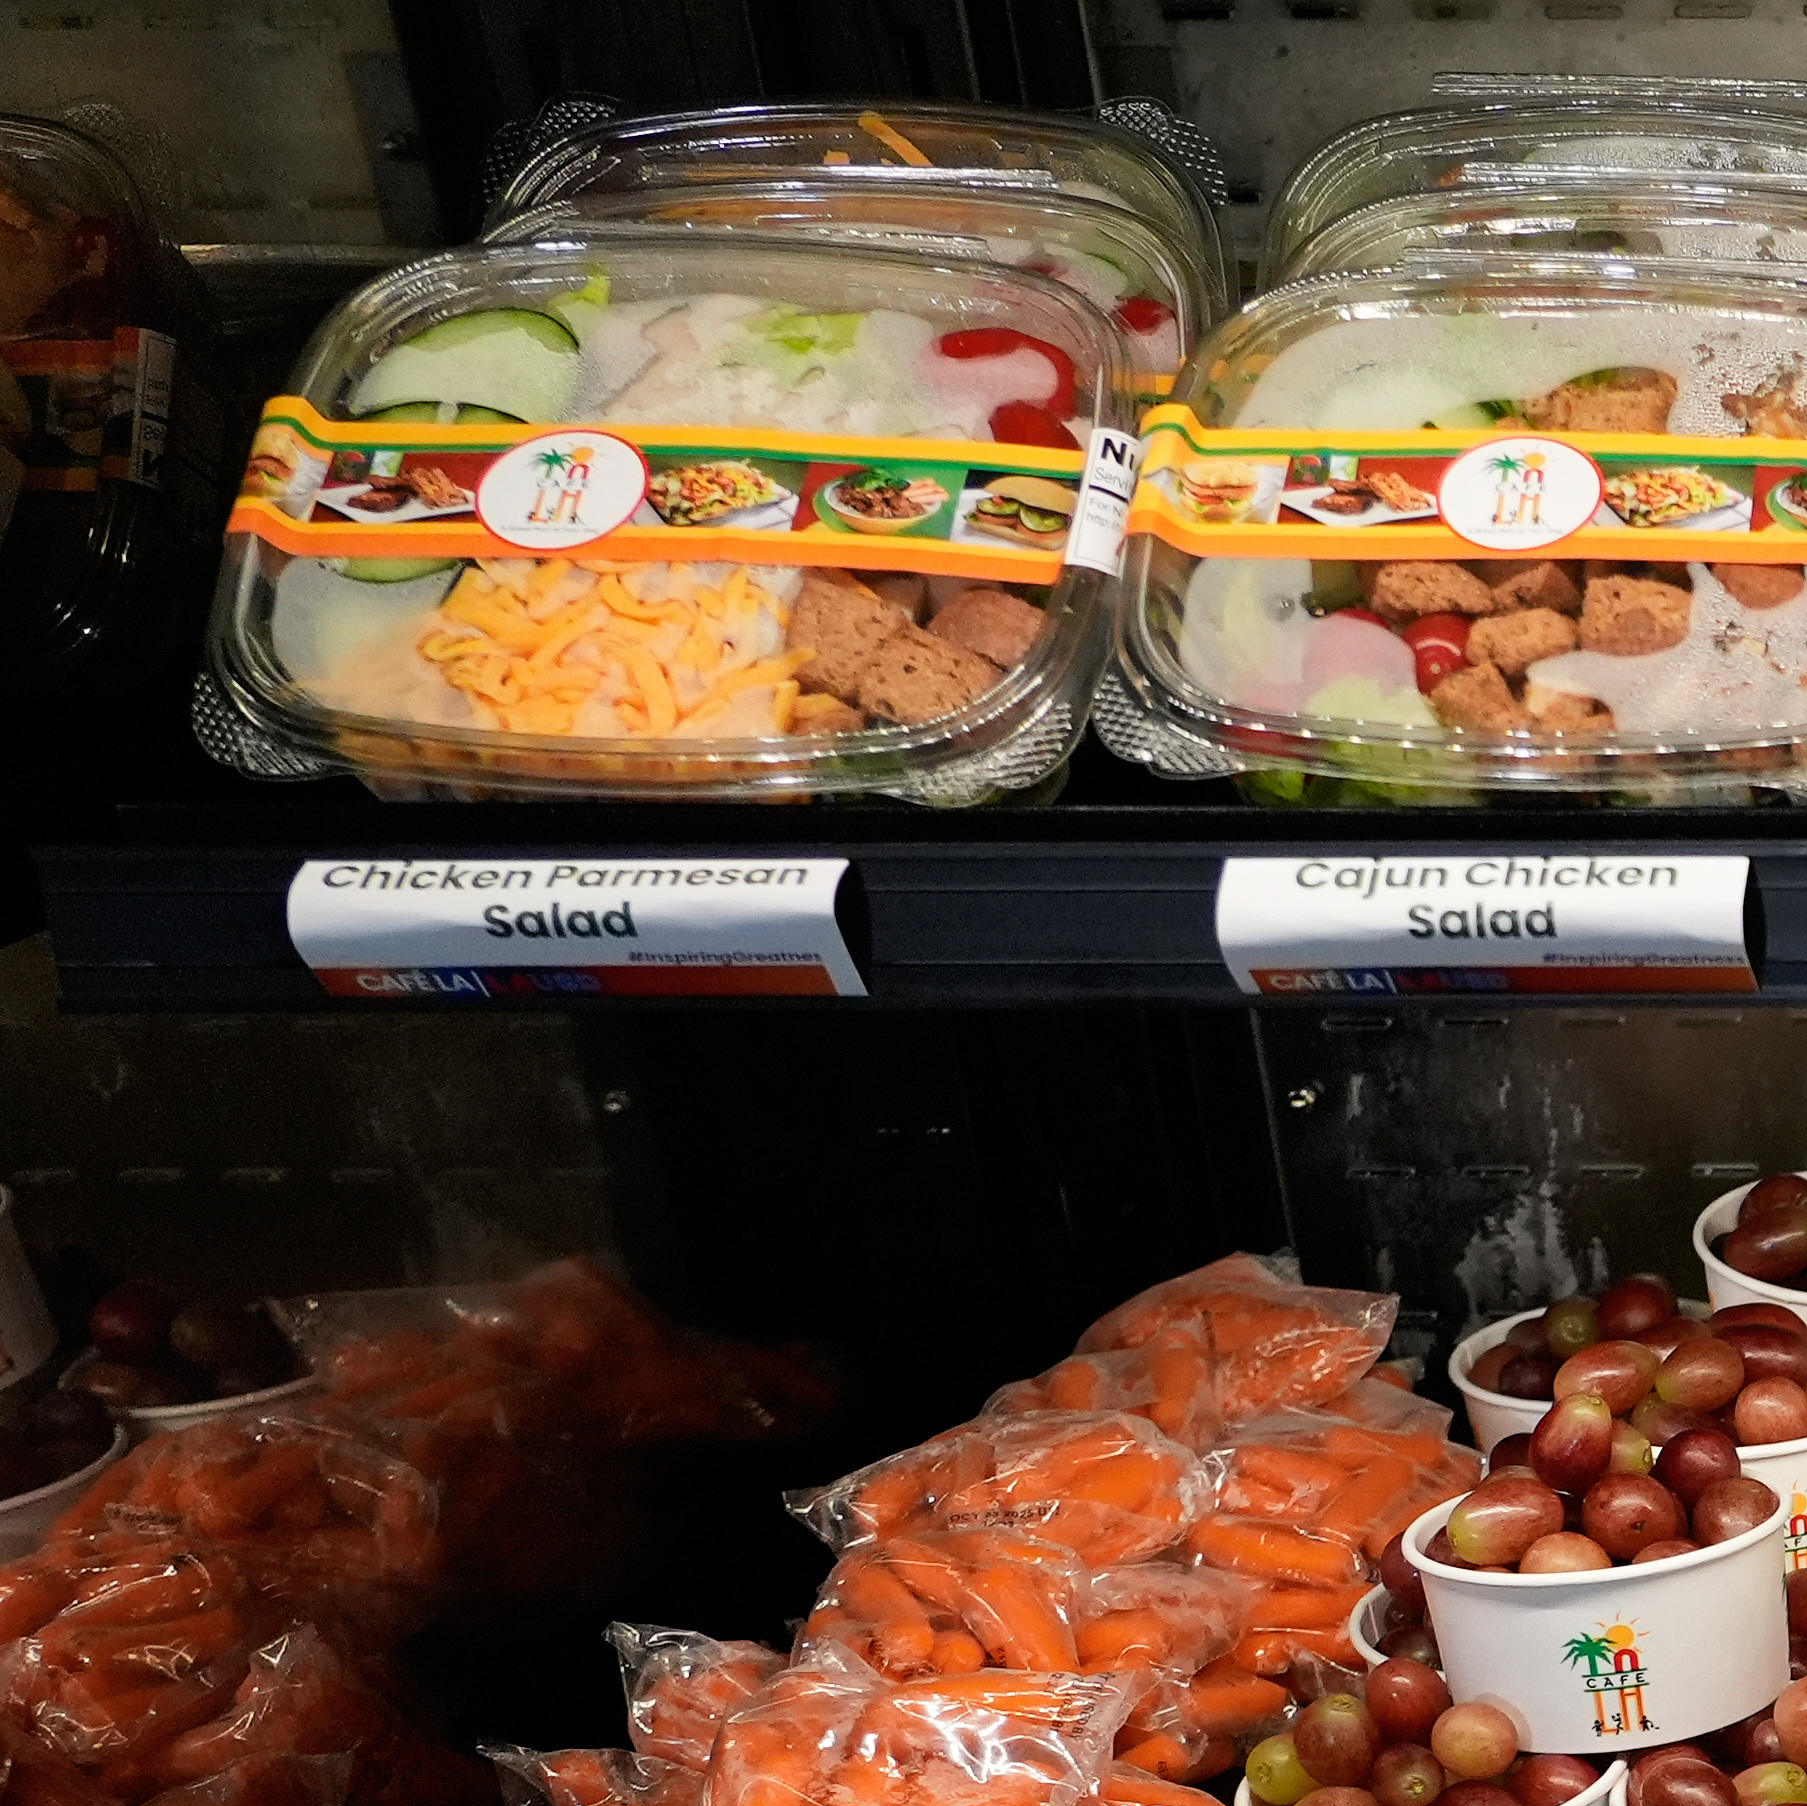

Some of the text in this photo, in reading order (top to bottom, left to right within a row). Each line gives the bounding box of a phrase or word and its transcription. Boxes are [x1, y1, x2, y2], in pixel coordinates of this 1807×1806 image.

[321, 859, 810, 890] Chicken Parmesan
[1296, 857, 1679, 899] Cajun Chicken
[483, 902, 638, 939] Salad
[1408, 902, 1558, 940] Salad
[1586, 1671, 1647, 1690] CAFE
